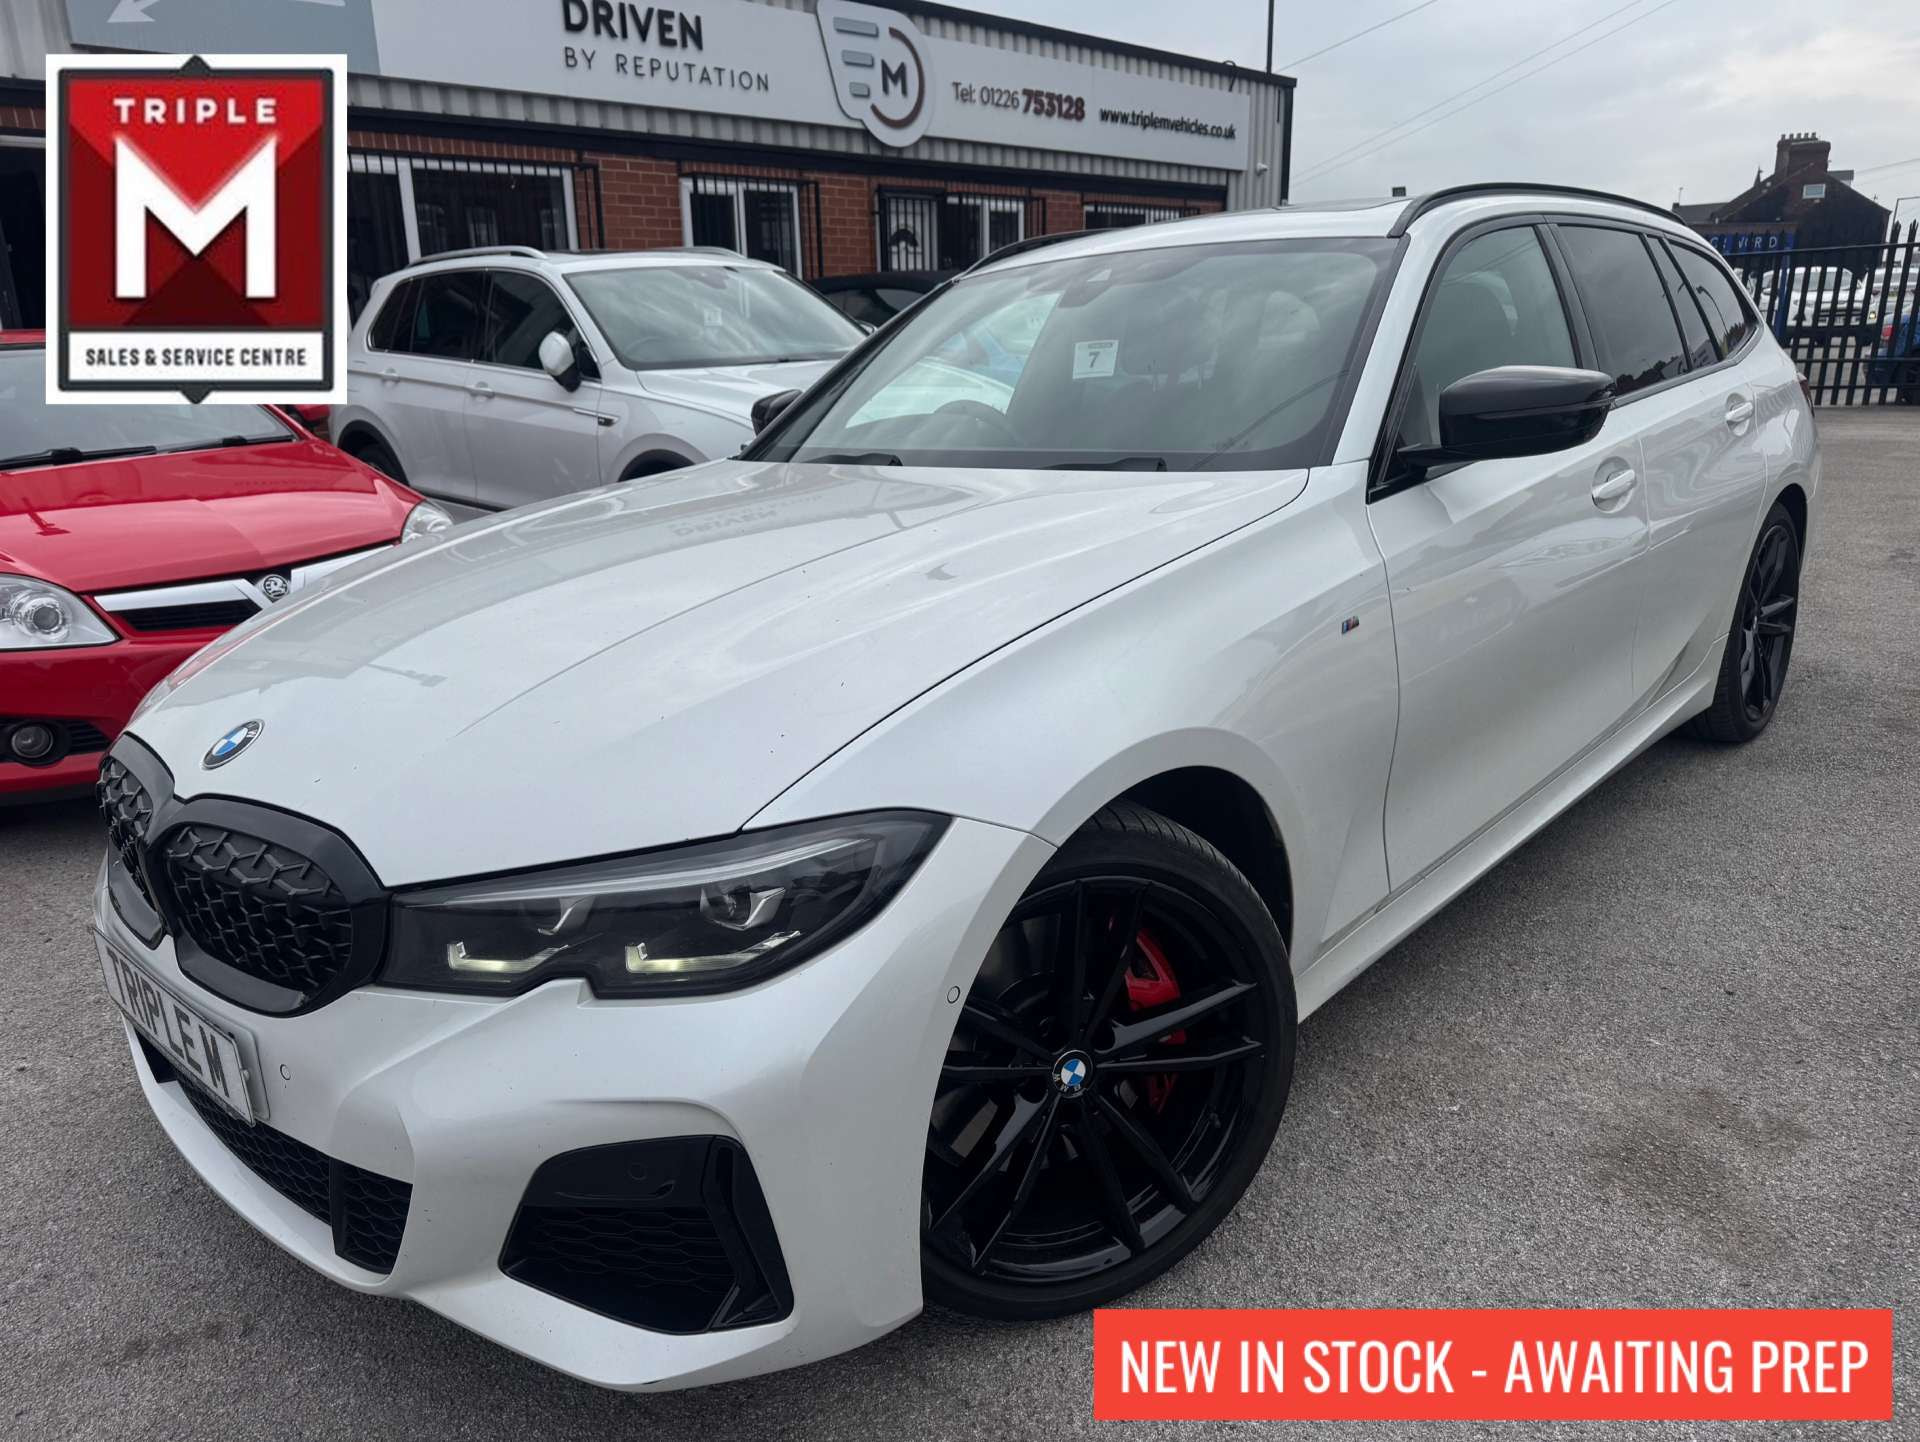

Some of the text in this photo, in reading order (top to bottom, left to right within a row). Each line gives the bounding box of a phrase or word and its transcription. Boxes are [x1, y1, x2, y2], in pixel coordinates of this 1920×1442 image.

[562, 0, 703, 51] DRIVEN
[564, 46, 769, 91] BY REPUTATION
[881, 59, 907, 96] M
[952, 81, 1236, 140] Tel: 01226 753128 www.triplemvehicles.co.uk
[1088, 351, 1100, 368] 7
